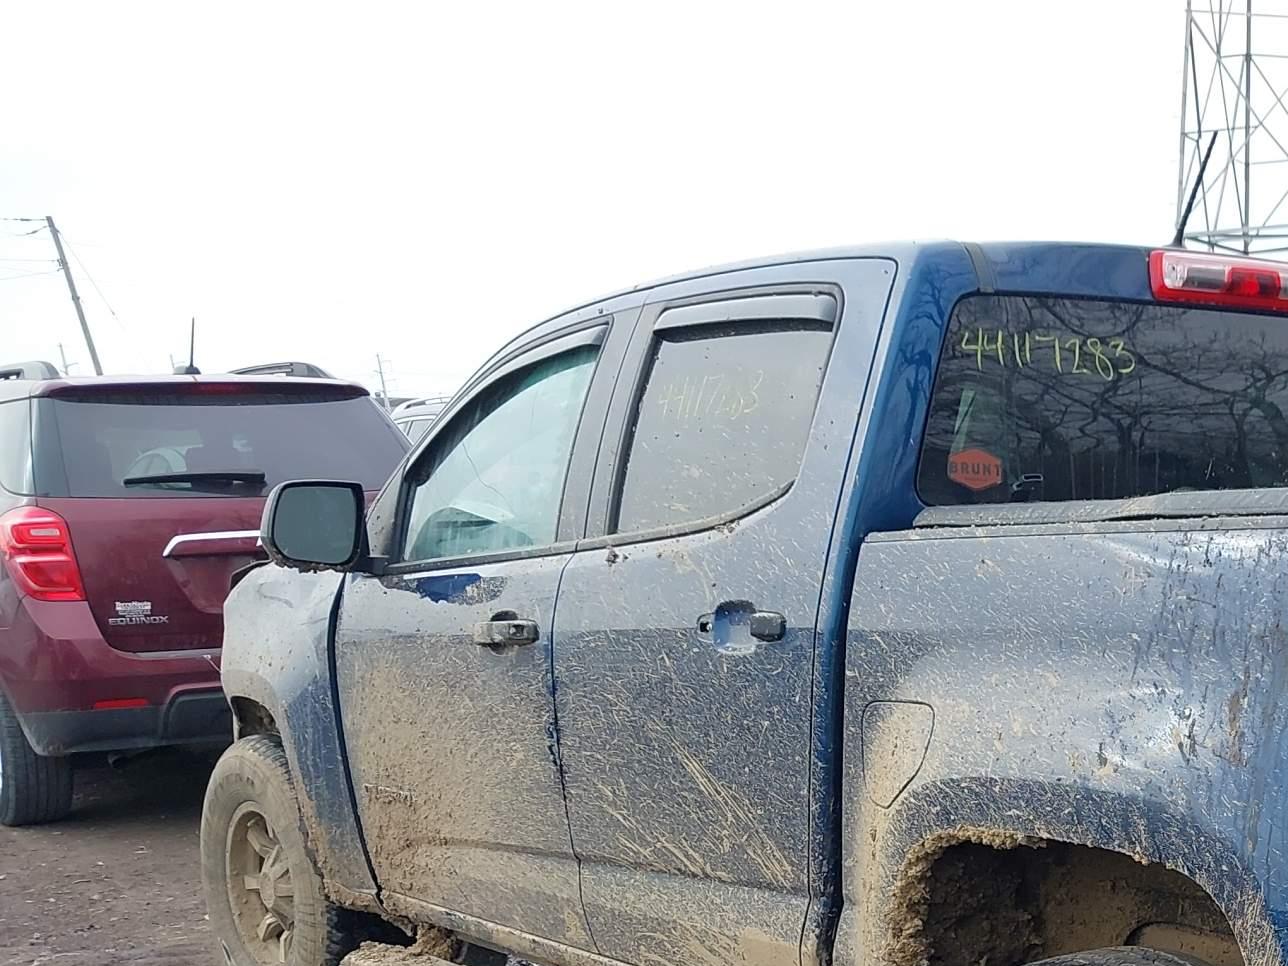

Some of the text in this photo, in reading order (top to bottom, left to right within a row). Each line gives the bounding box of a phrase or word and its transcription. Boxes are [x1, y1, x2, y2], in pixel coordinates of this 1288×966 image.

[961, 327, 1136, 381] 44117283
[949, 461, 1000, 477] BRUNT
[108, 615, 169, 626] EQUINOX
